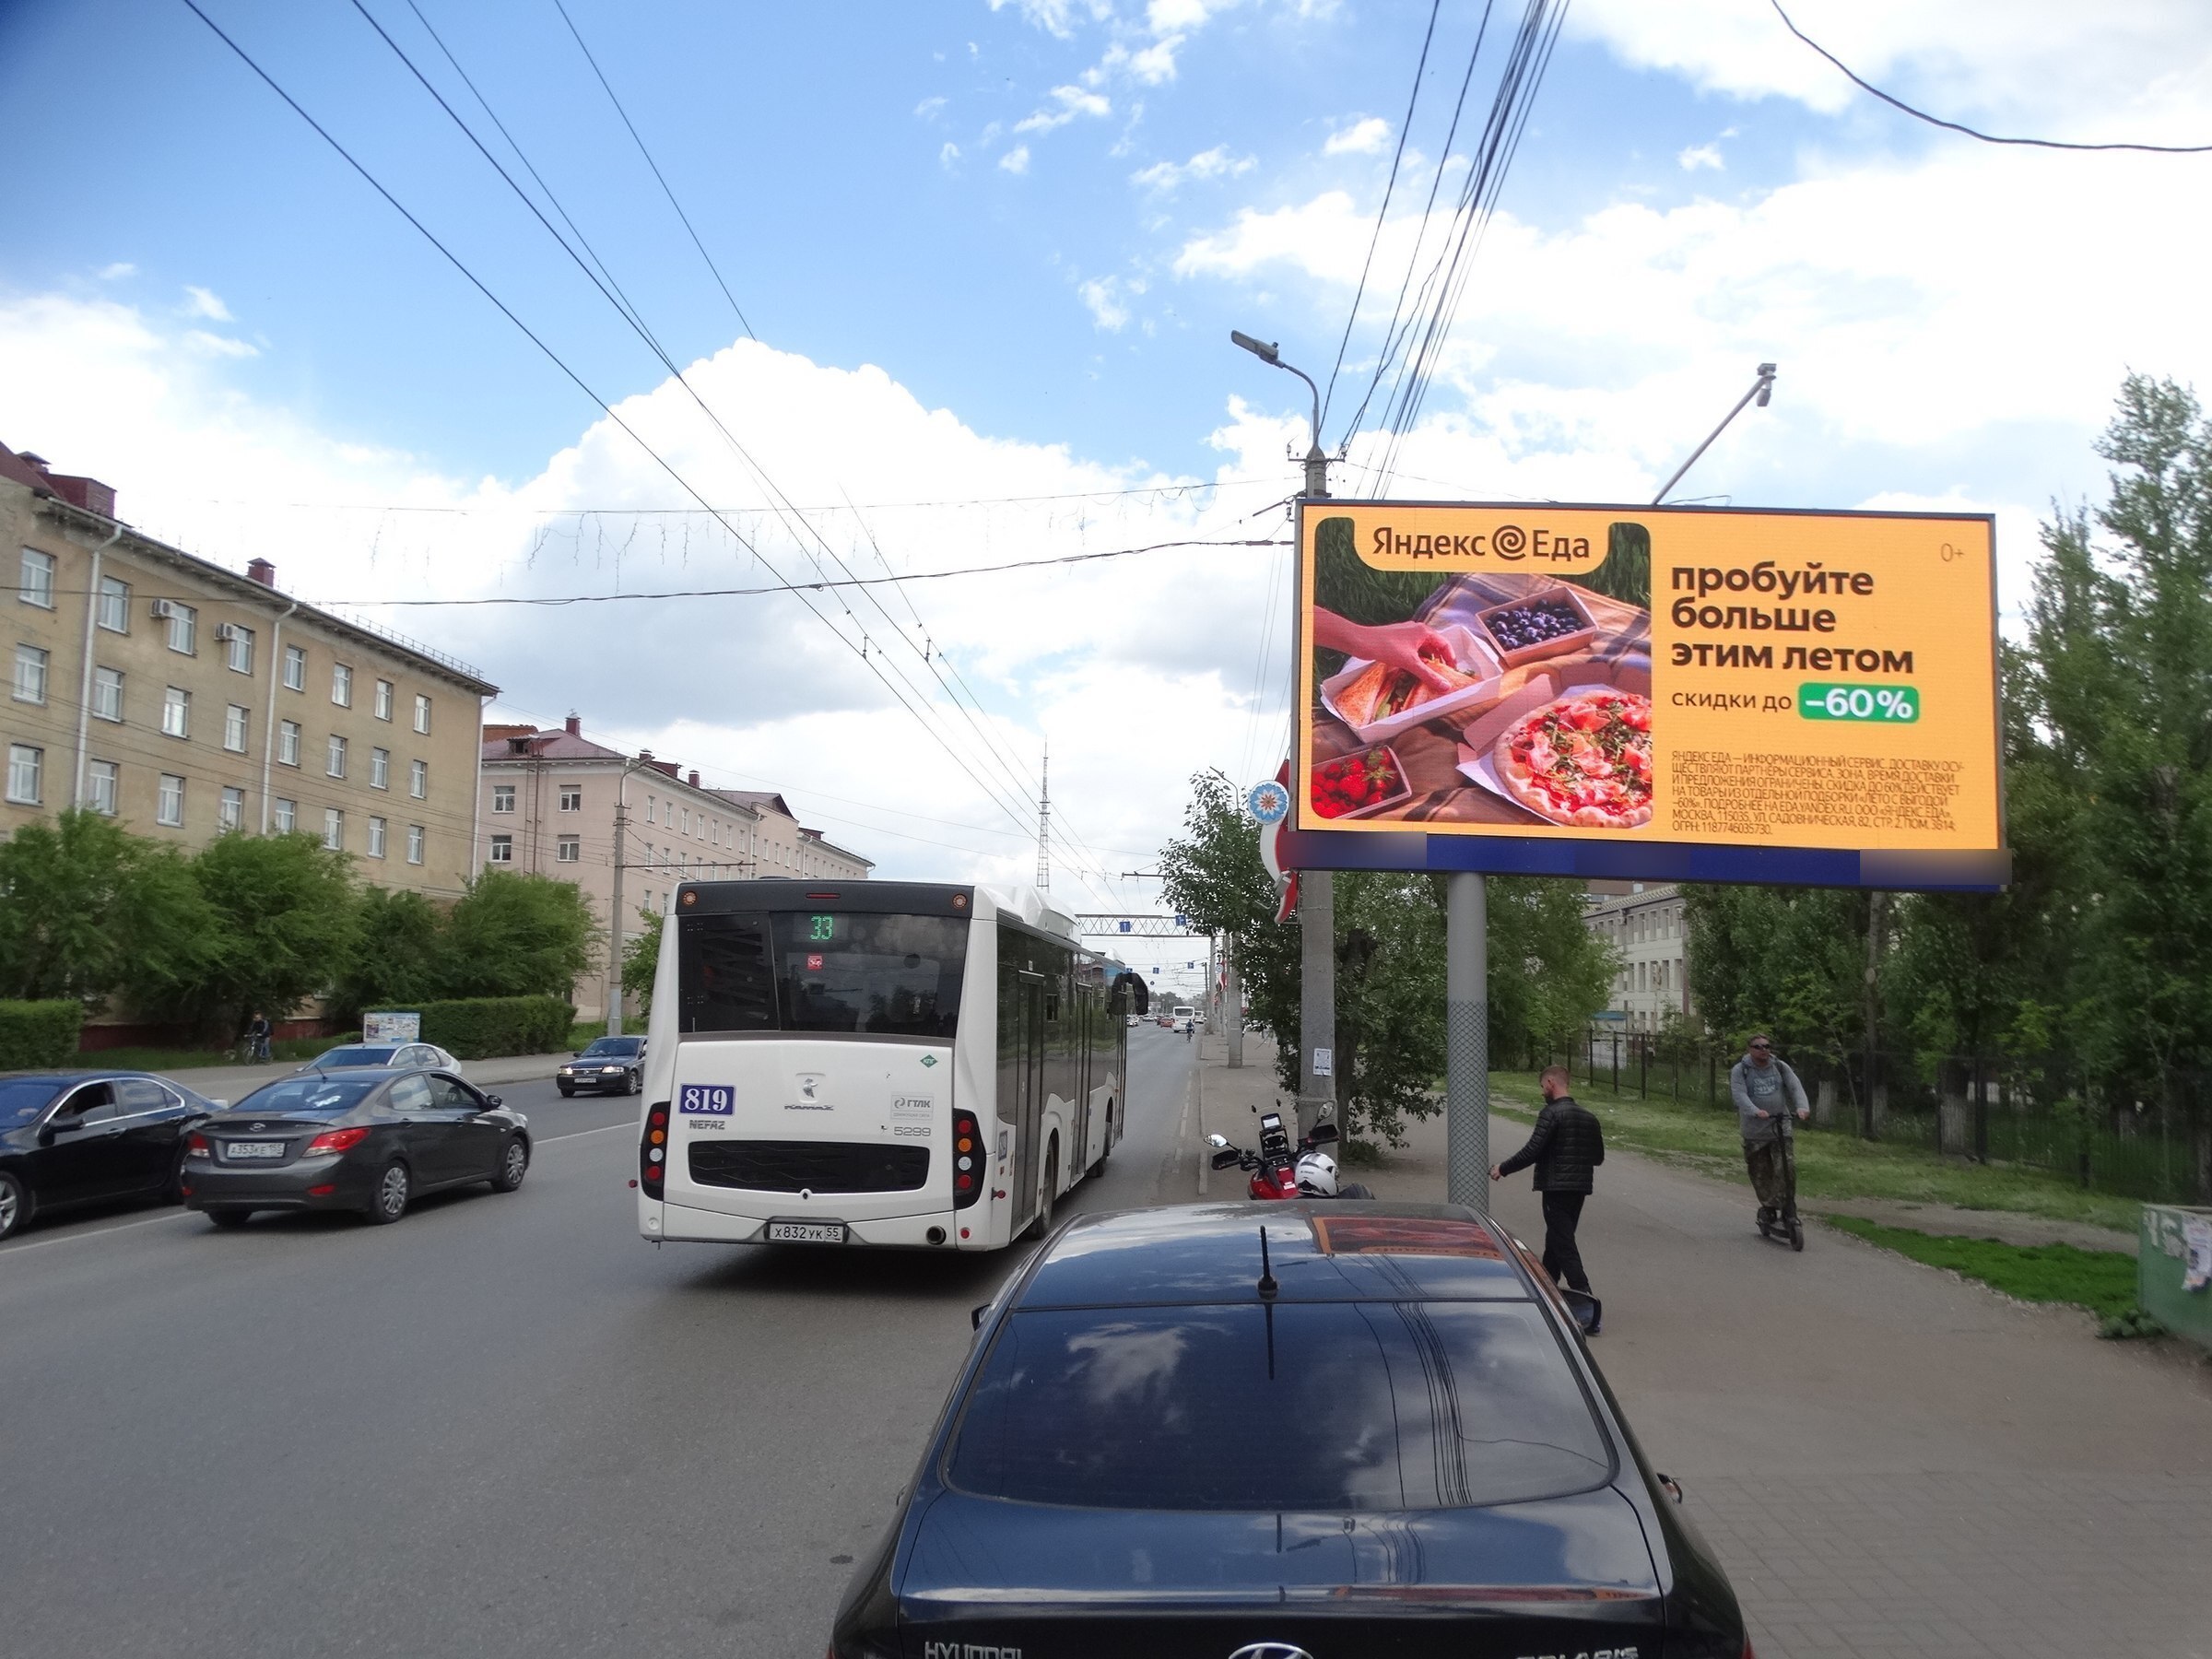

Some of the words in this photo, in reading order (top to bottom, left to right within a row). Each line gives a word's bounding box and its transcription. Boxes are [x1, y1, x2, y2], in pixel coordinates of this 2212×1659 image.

[1372, 526, 1486, 559] Яндекс
[1533, 529, 1590, 562] Еда
[1940, 542, 1965, 562] 0+
[1671, 559, 1874, 601] пробуйте
[1671, 595, 1836, 633] больше
[1671, 642, 1773, 669] этим
[1783, 645, 1914, 674] летом
[1671, 691, 1756, 712] скидки
[1762, 694, 1792, 713] до
[1805, 687, 1913, 720] -60%
[1672, 750, 1710, 762] ЯНДЕКС
[1712, 752, 1731, 763] ЕДА
[1672, 774, 1679, 784] И
[1868, 781, 1883, 793] ДО
[1672, 786, 1686, 796] НА
[1688, 786, 1727, 798] ТОВАРЫ
[1728, 788, 1741, 798] ИЗ
[1704, 798, 1762, 811] ПОДРОБНЕЕ
[1765, 801, 1779, 811] НА
[810, 915, 833, 940] 33
[684, 1088, 728, 1112] 819
[907, 1100, 931, 1109] ГТЛК
[688, 1119, 726, 1130] NEFAZ
[894, 1126, 931, 1136] 5299
[826, 1227, 839, 1237] 55
